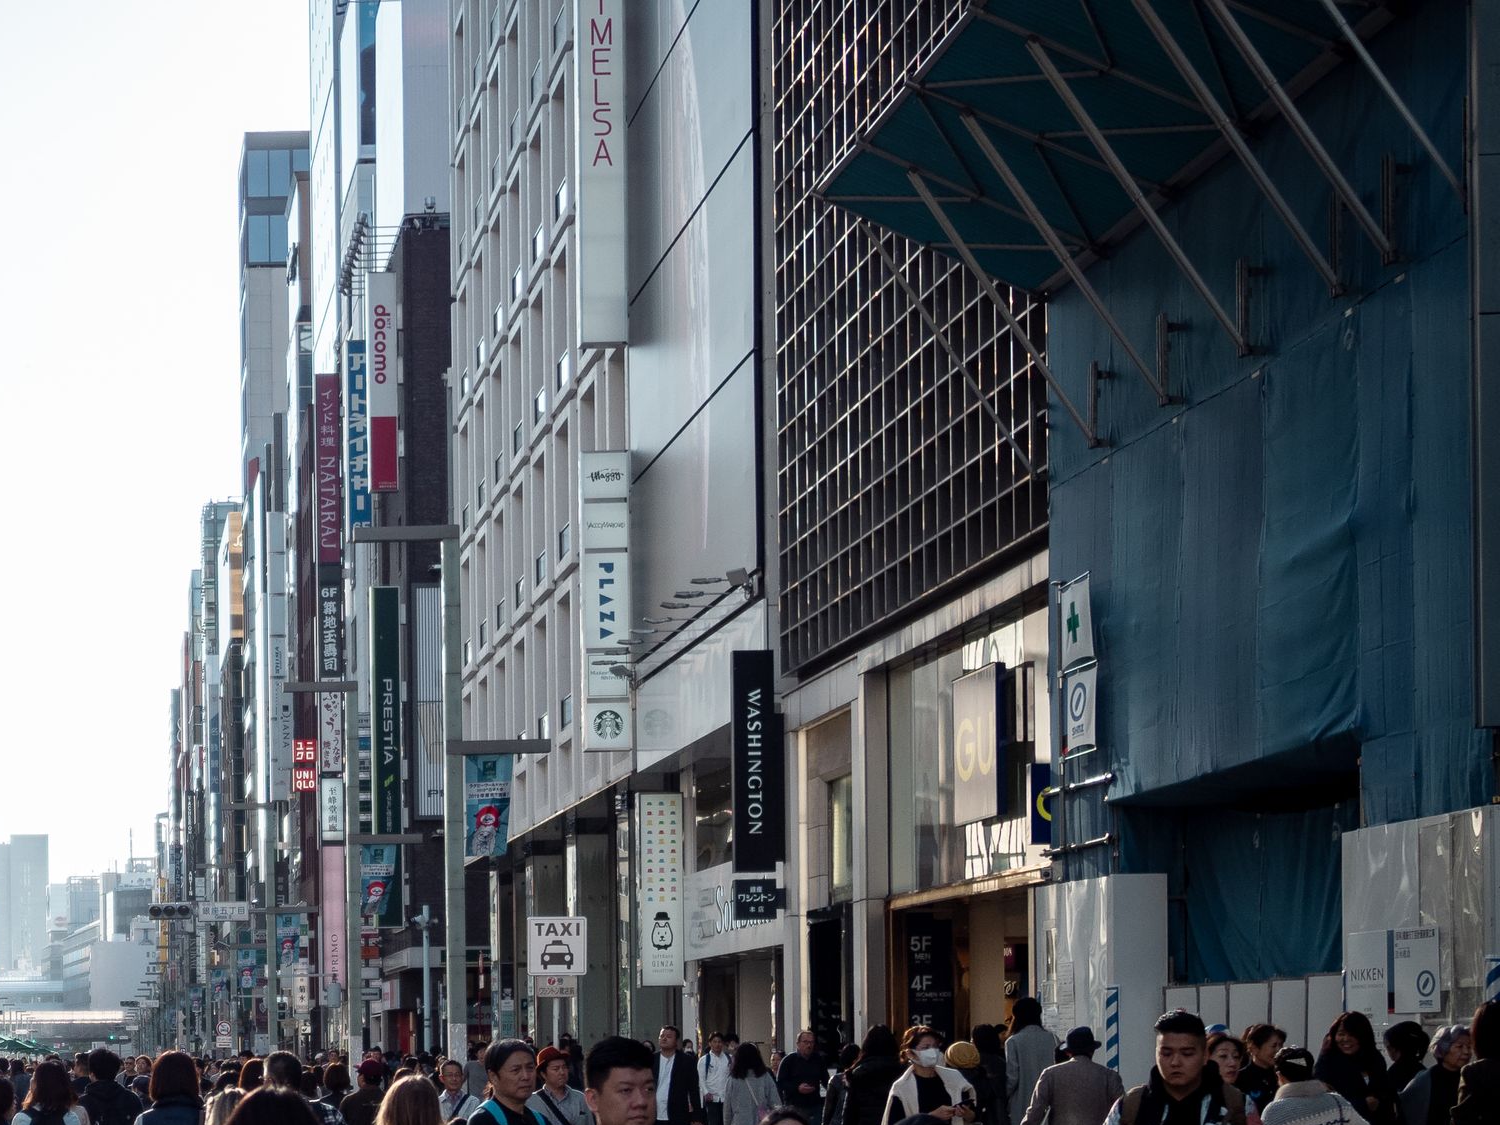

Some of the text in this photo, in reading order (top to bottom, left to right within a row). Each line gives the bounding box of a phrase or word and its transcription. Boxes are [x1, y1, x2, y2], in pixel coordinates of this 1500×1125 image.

[374, 304, 390, 385] docomo
[320, 389, 336, 448] インド料理
[320, 455, 337, 548] NATARAJ
[321, 588, 337, 598] 6F
[598, 562, 616, 640] PLAZA
[383, 678, 398, 765] PRESTÍA
[281, 711, 293, 750] DIANA
[956, 715, 994, 785] GU
[747, 687, 763, 835] WASHINGTON
[296, 771, 315, 780] UNI
[296, 780, 315, 789] QLO
[737, 893, 776, 903] ワシントン
[203, 906, 245, 916] 銀座五丁目
[535, 922, 580, 937] TAXI
[910, 936, 932, 951] 5F
[651, 960, 674, 968] GINZA
[1350, 967, 1384, 982] NIKKEN
[910, 975, 933, 991] 4F
